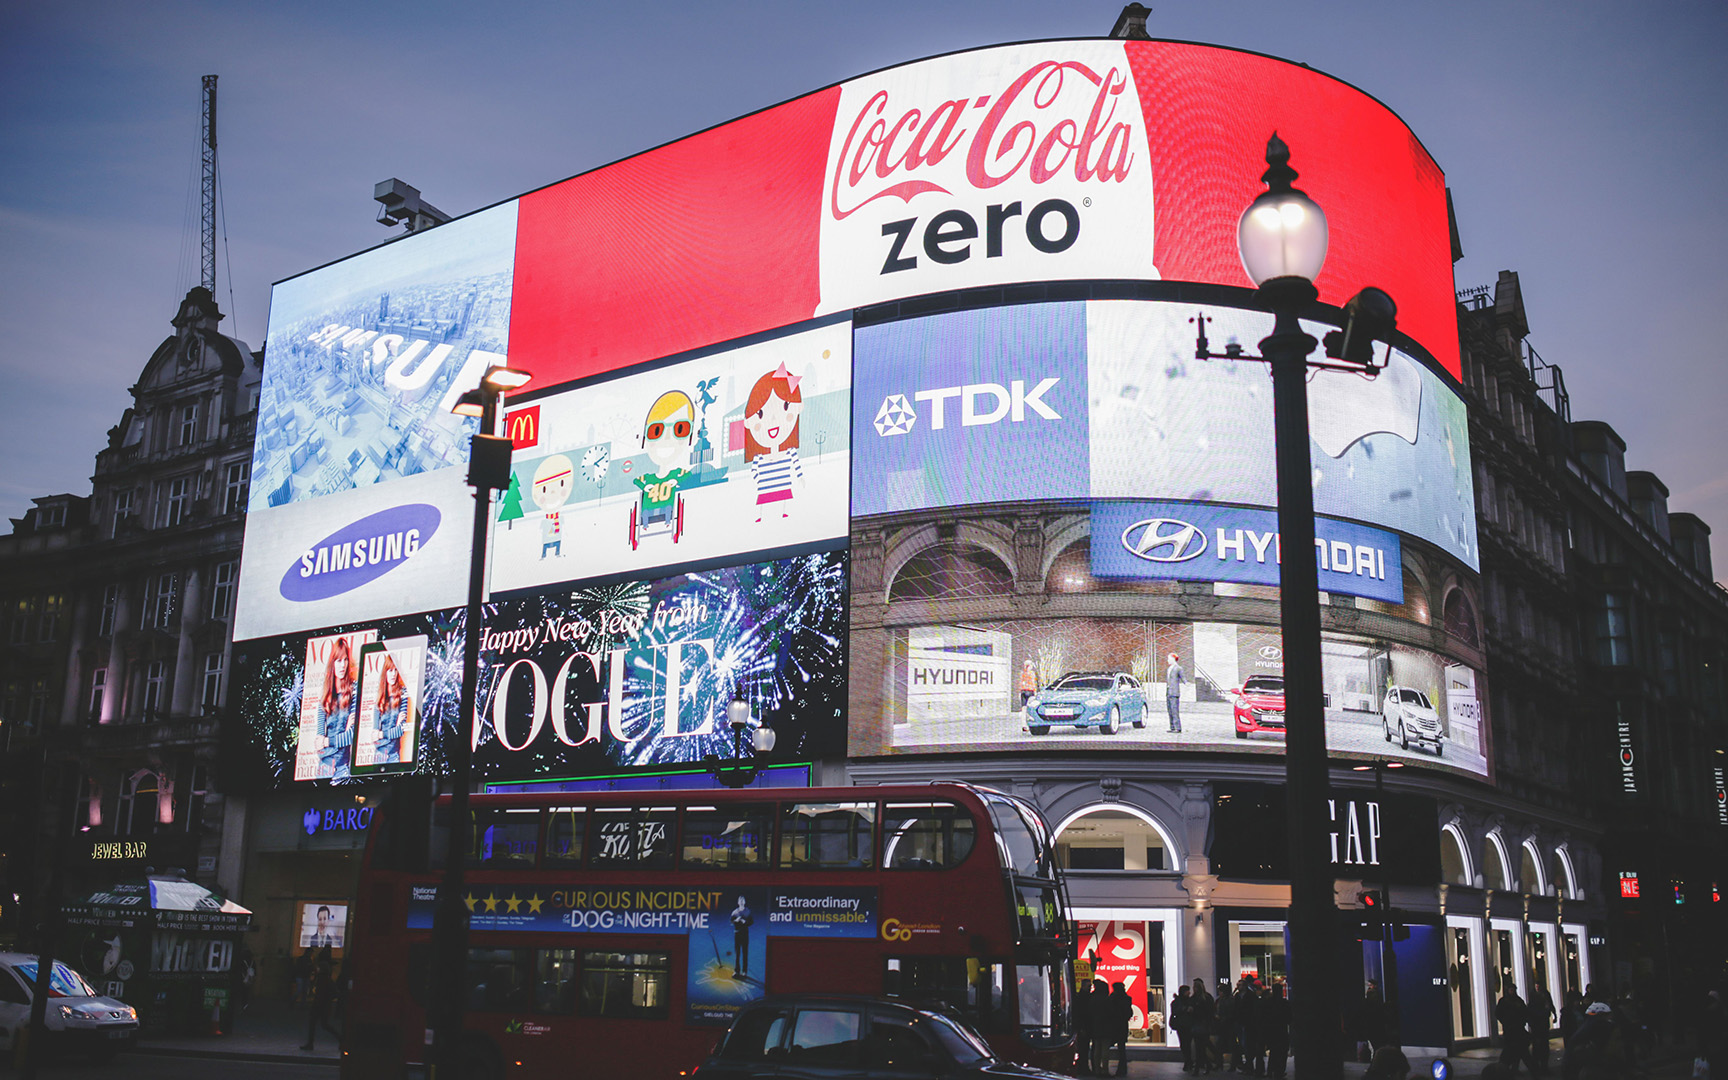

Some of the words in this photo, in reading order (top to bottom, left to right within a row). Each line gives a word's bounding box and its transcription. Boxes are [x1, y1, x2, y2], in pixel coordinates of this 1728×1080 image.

[832, 59, 1136, 220] Coca-Cola
[880, 197, 1081, 275] zero
[915, 377, 1063, 430] TDK
[647, 483, 671, 503] 40
[300, 529, 420, 578] SAMSUNG
[1216, 528, 1384, 581] HYNDAI
[542, 616, 591, 643] New
[597, 608, 648, 636] Year
[651, 601, 707, 630] from
[913, 667, 994, 686] HYUNDAI
[91, 843, 123, 859] JEWEL
[124, 841, 147, 858] BAR
[551, 890, 631, 909] CURIOUS
[635, 890, 722, 910] INCIDENT
[571, 910, 614, 928] DOG
[624, 910, 709, 930] NIGHT-TIME
[769, 911, 792, 922] and
[881, 918, 911, 941] Go
[1079, 920, 1144, 960] 75
[150, 931, 233, 973] WICKED
[1111, 964, 1125, 972] good
